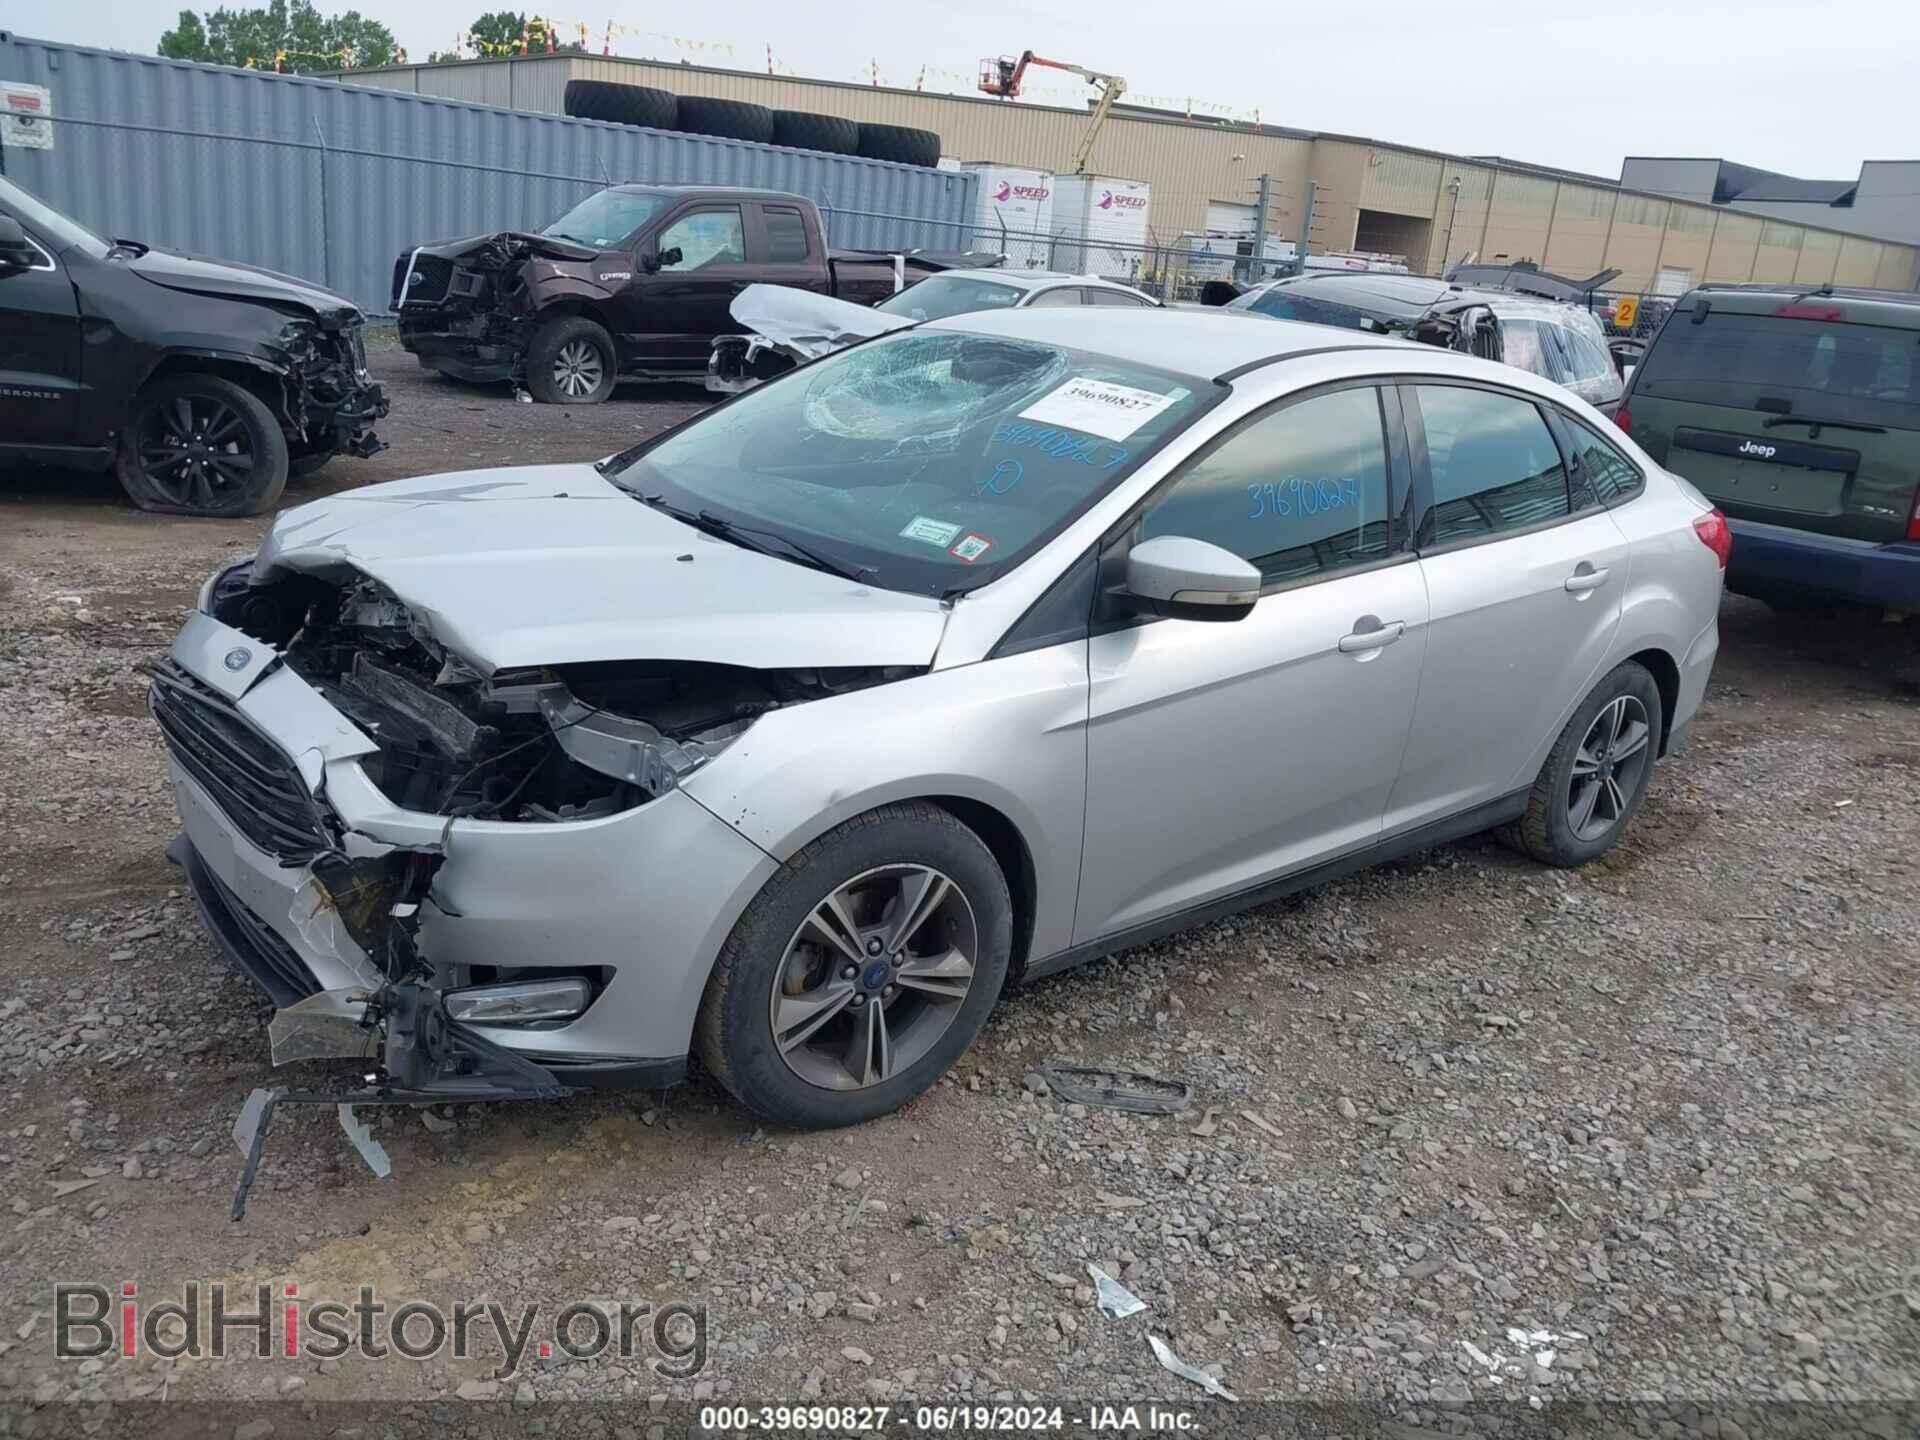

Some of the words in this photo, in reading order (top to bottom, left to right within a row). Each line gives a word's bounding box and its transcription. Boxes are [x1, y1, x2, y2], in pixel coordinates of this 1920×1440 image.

[1012, 185, 1049, 198] SPEED
[1113, 194, 1146, 207] SPEED
[1620, 303, 1631, 321] 2
[0, 388, 61, 400] EROKEE
[1739, 440, 1776, 458] Jeep
[1247, 477, 1359, 519] 39690827
